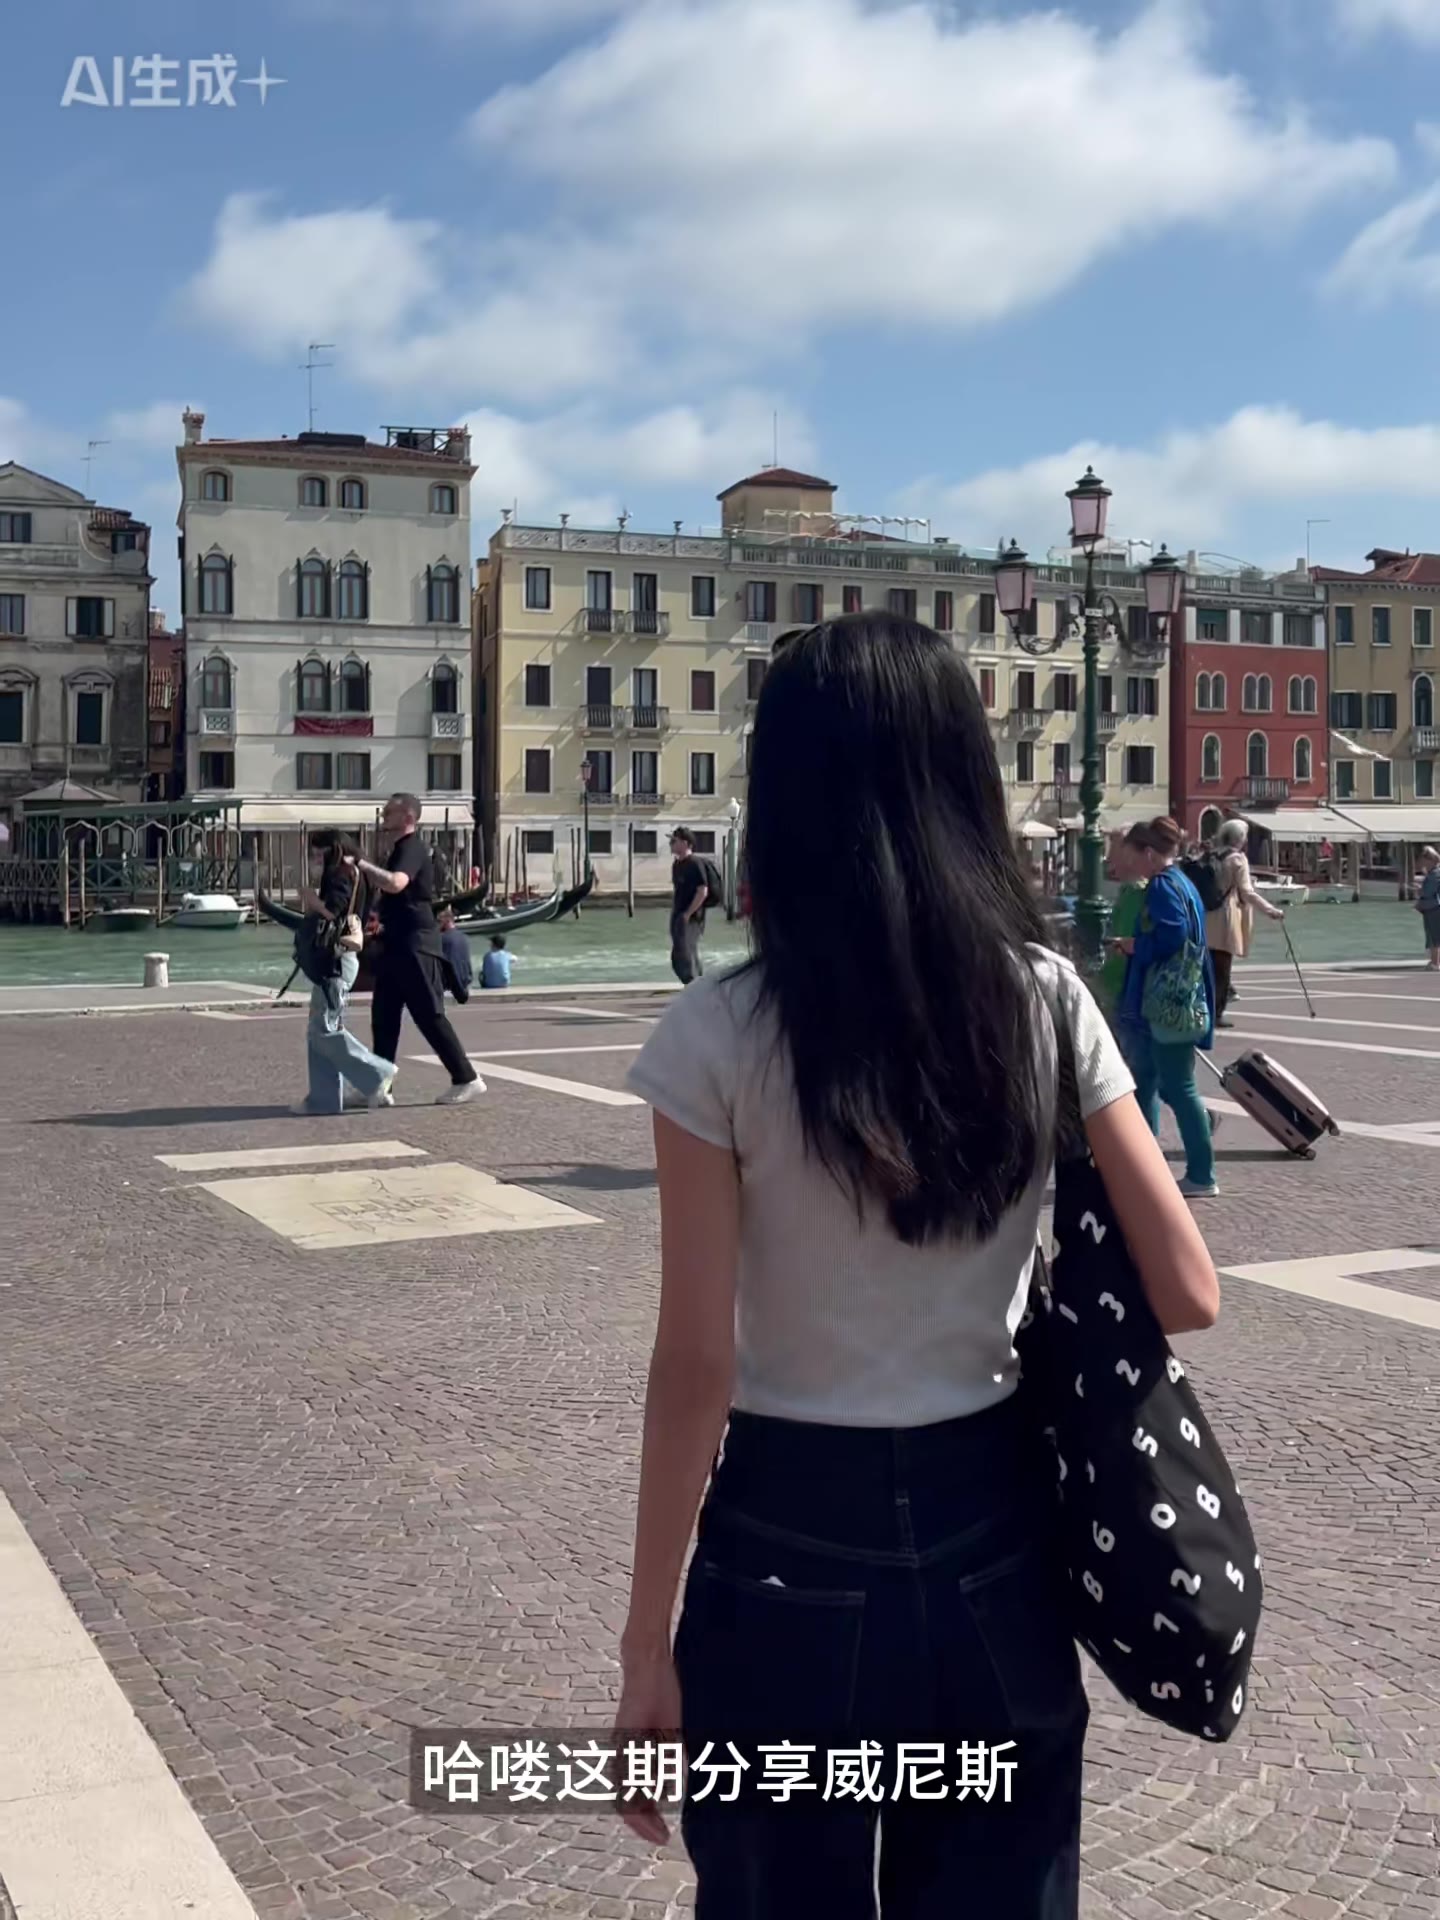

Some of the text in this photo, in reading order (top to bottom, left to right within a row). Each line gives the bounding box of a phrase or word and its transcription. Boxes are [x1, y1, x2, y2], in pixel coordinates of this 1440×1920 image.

[1080, 1210, 1107, 1244] 2
[1098, 1291, 1125, 1322] 3
[1115, 1359, 1141, 1386] 2
[1132, 1427, 1158, 1457] 5
[1196, 1484, 1221, 1519] 8
[1092, 1520, 1115, 1553] 6
[1082, 1570, 1103, 1603] 8
[1170, 1568, 1202, 1596] 2
[1153, 1612, 1180, 1633] 7
[1150, 1681, 1181, 1699] 5
